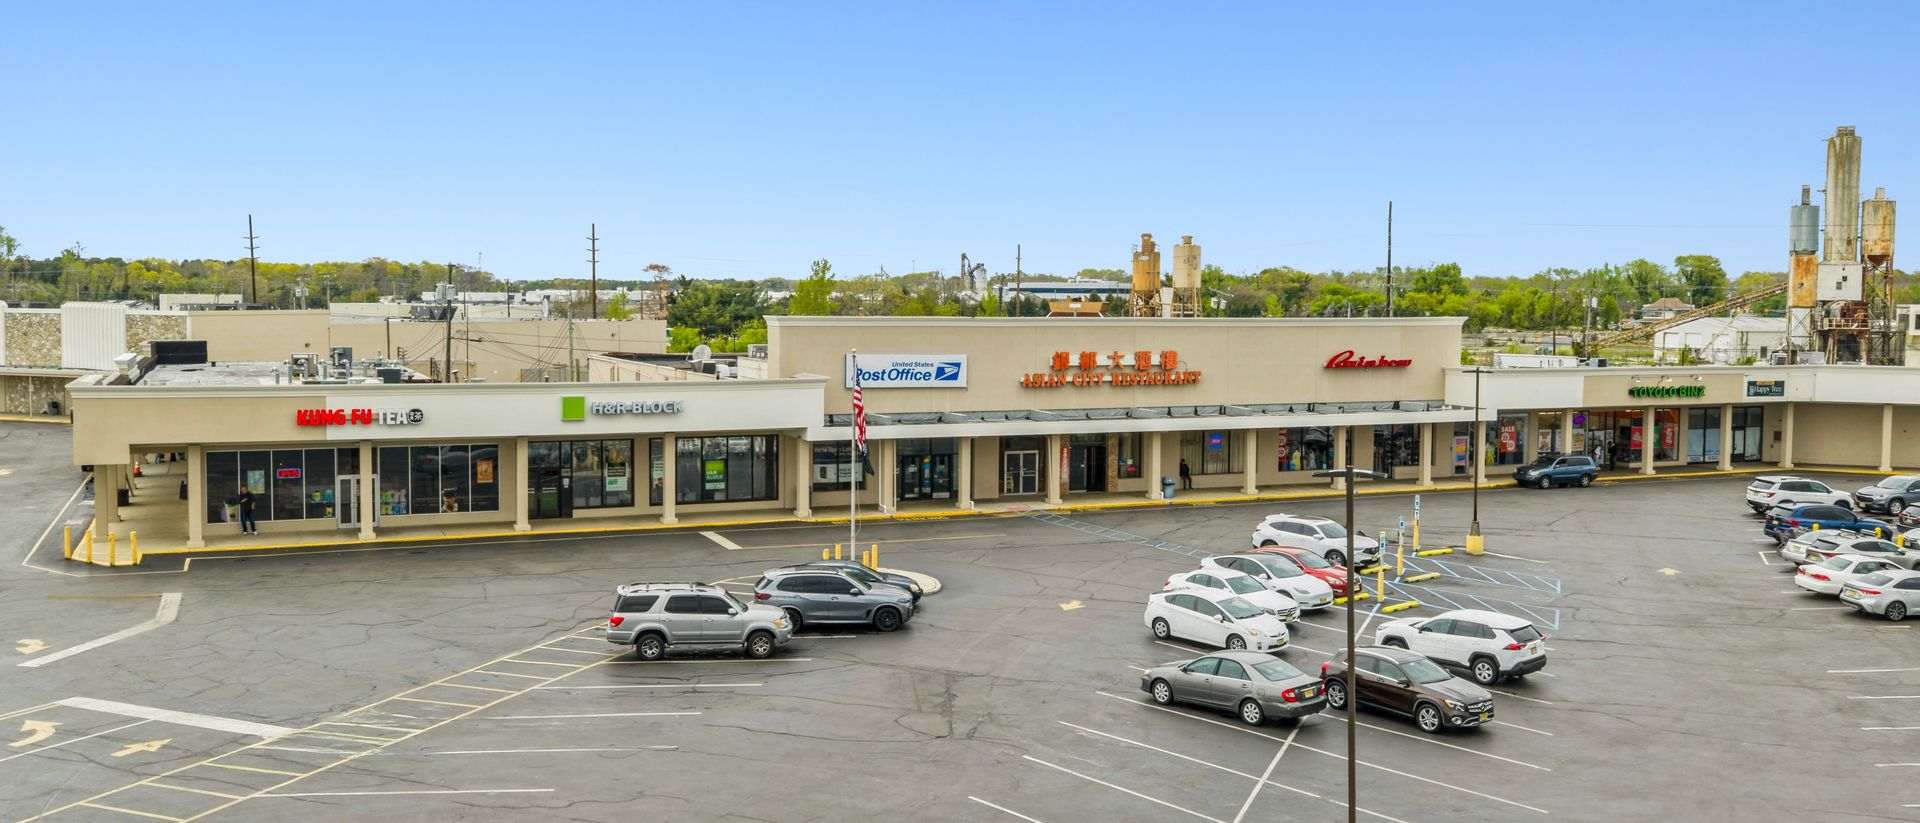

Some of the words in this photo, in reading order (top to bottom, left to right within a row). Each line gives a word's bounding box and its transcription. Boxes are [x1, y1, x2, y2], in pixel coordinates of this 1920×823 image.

[1325, 350, 1412, 368] Rainbow
[857, 368, 887, 381] Post
[888, 368, 931, 381] Office
[1023, 373, 1067, 387] ASIAN
[1073, 372, 1105, 386] CITY
[1111, 371, 1201, 386] RESTAURANT
[1632, 386, 1676, 397] TOYOLO
[592, 402, 627, 414] H&R
[632, 401, 684, 413] BLOCK
[297, 409, 346, 426] KUNG
[351, 409, 372, 425] FU
[377, 409, 408, 424] TEA
